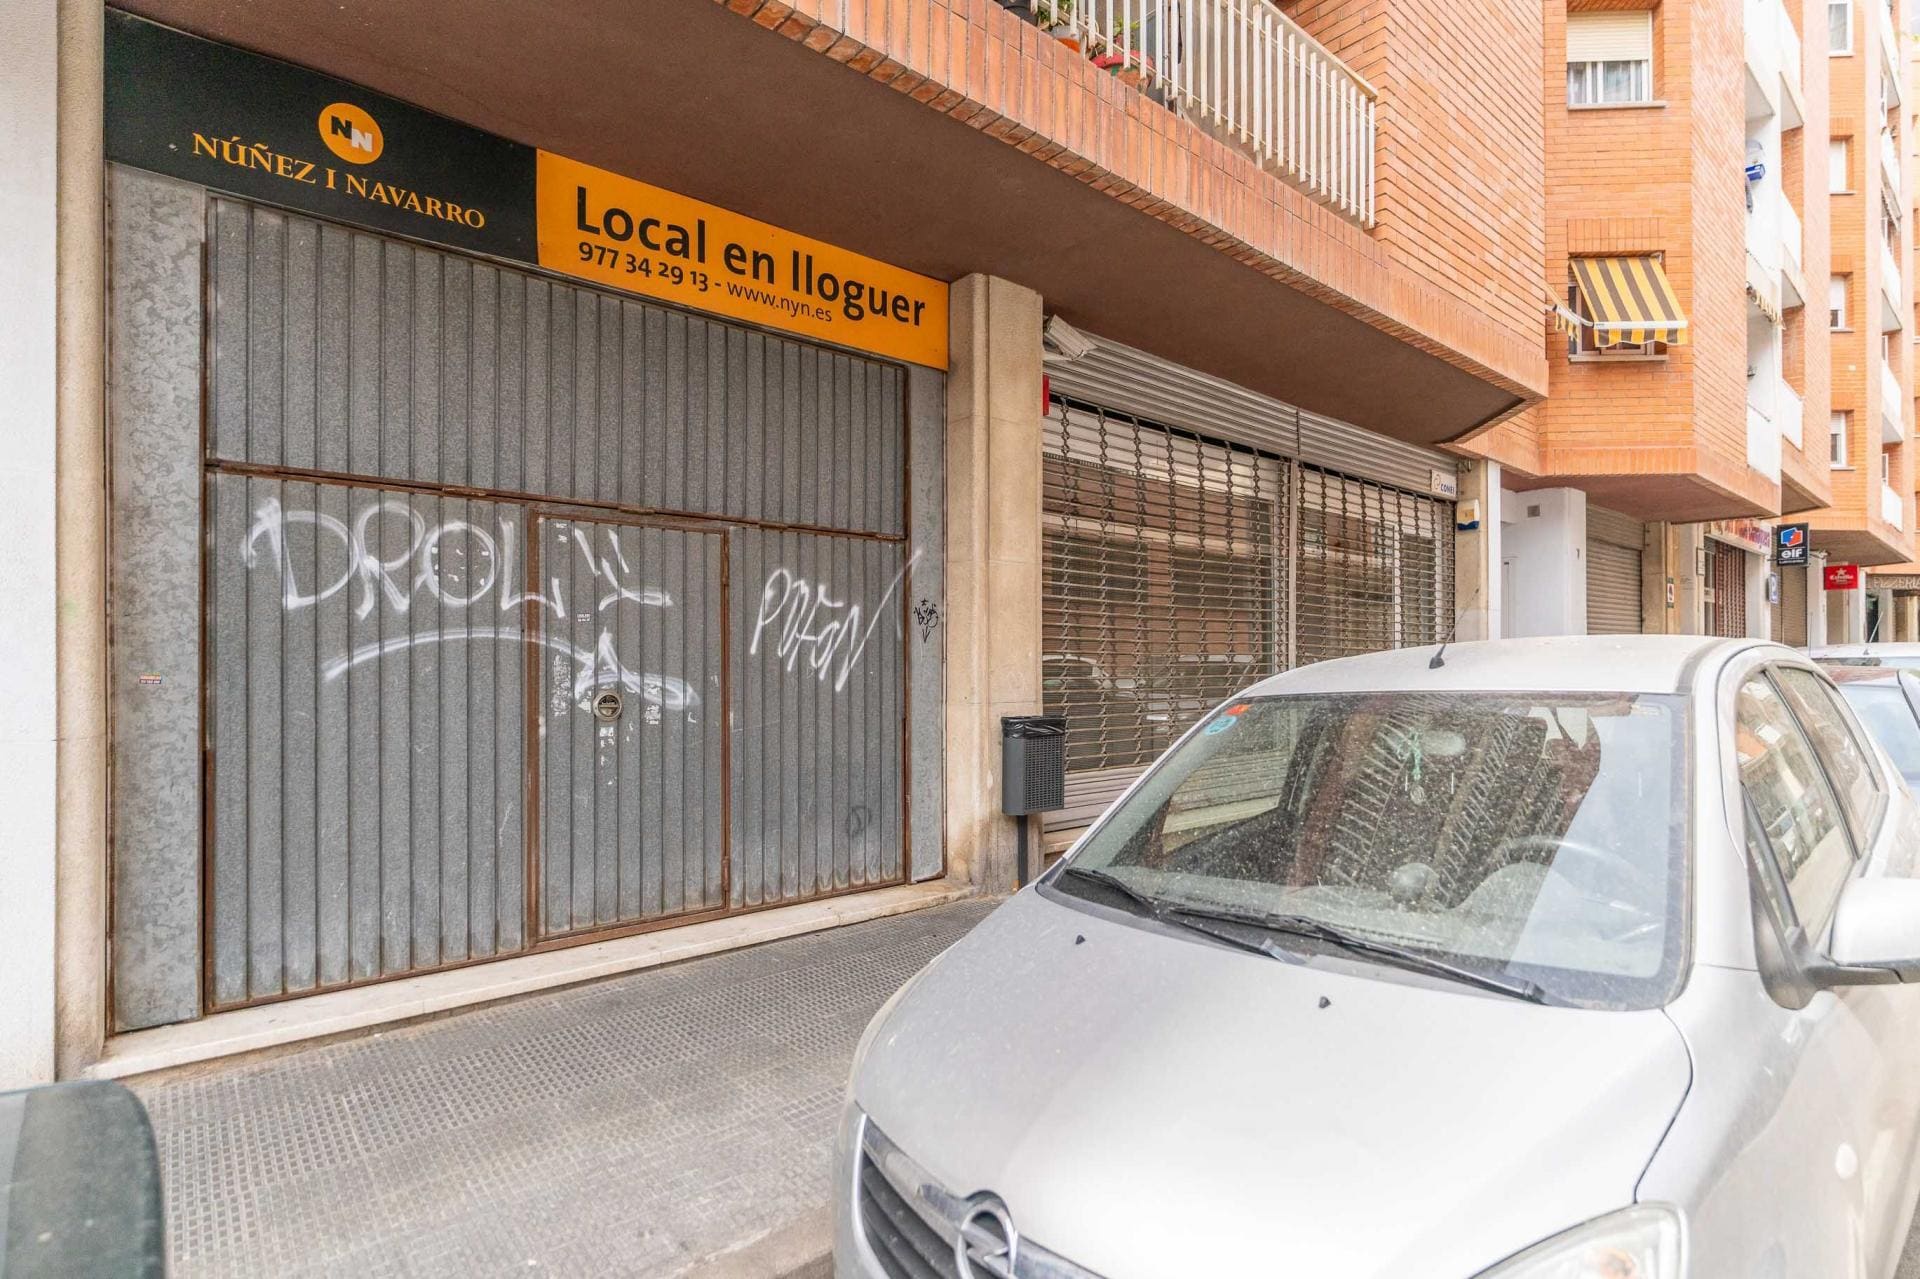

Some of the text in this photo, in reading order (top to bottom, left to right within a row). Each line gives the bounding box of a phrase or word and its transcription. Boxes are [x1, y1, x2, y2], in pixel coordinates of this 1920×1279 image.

[192, 131, 485, 229] NÚÑEZ I NAVARRO
[576, 185, 927, 327] Local en lloguer
[578, 241, 620, 270] 977
[625, 253, 653, 278] 34
[658, 262, 684, 286] 29
[689, 270, 709, 293] 13
[726, 280, 833, 323] www.nyn.es
[1781, 548, 1803, 559] elf
